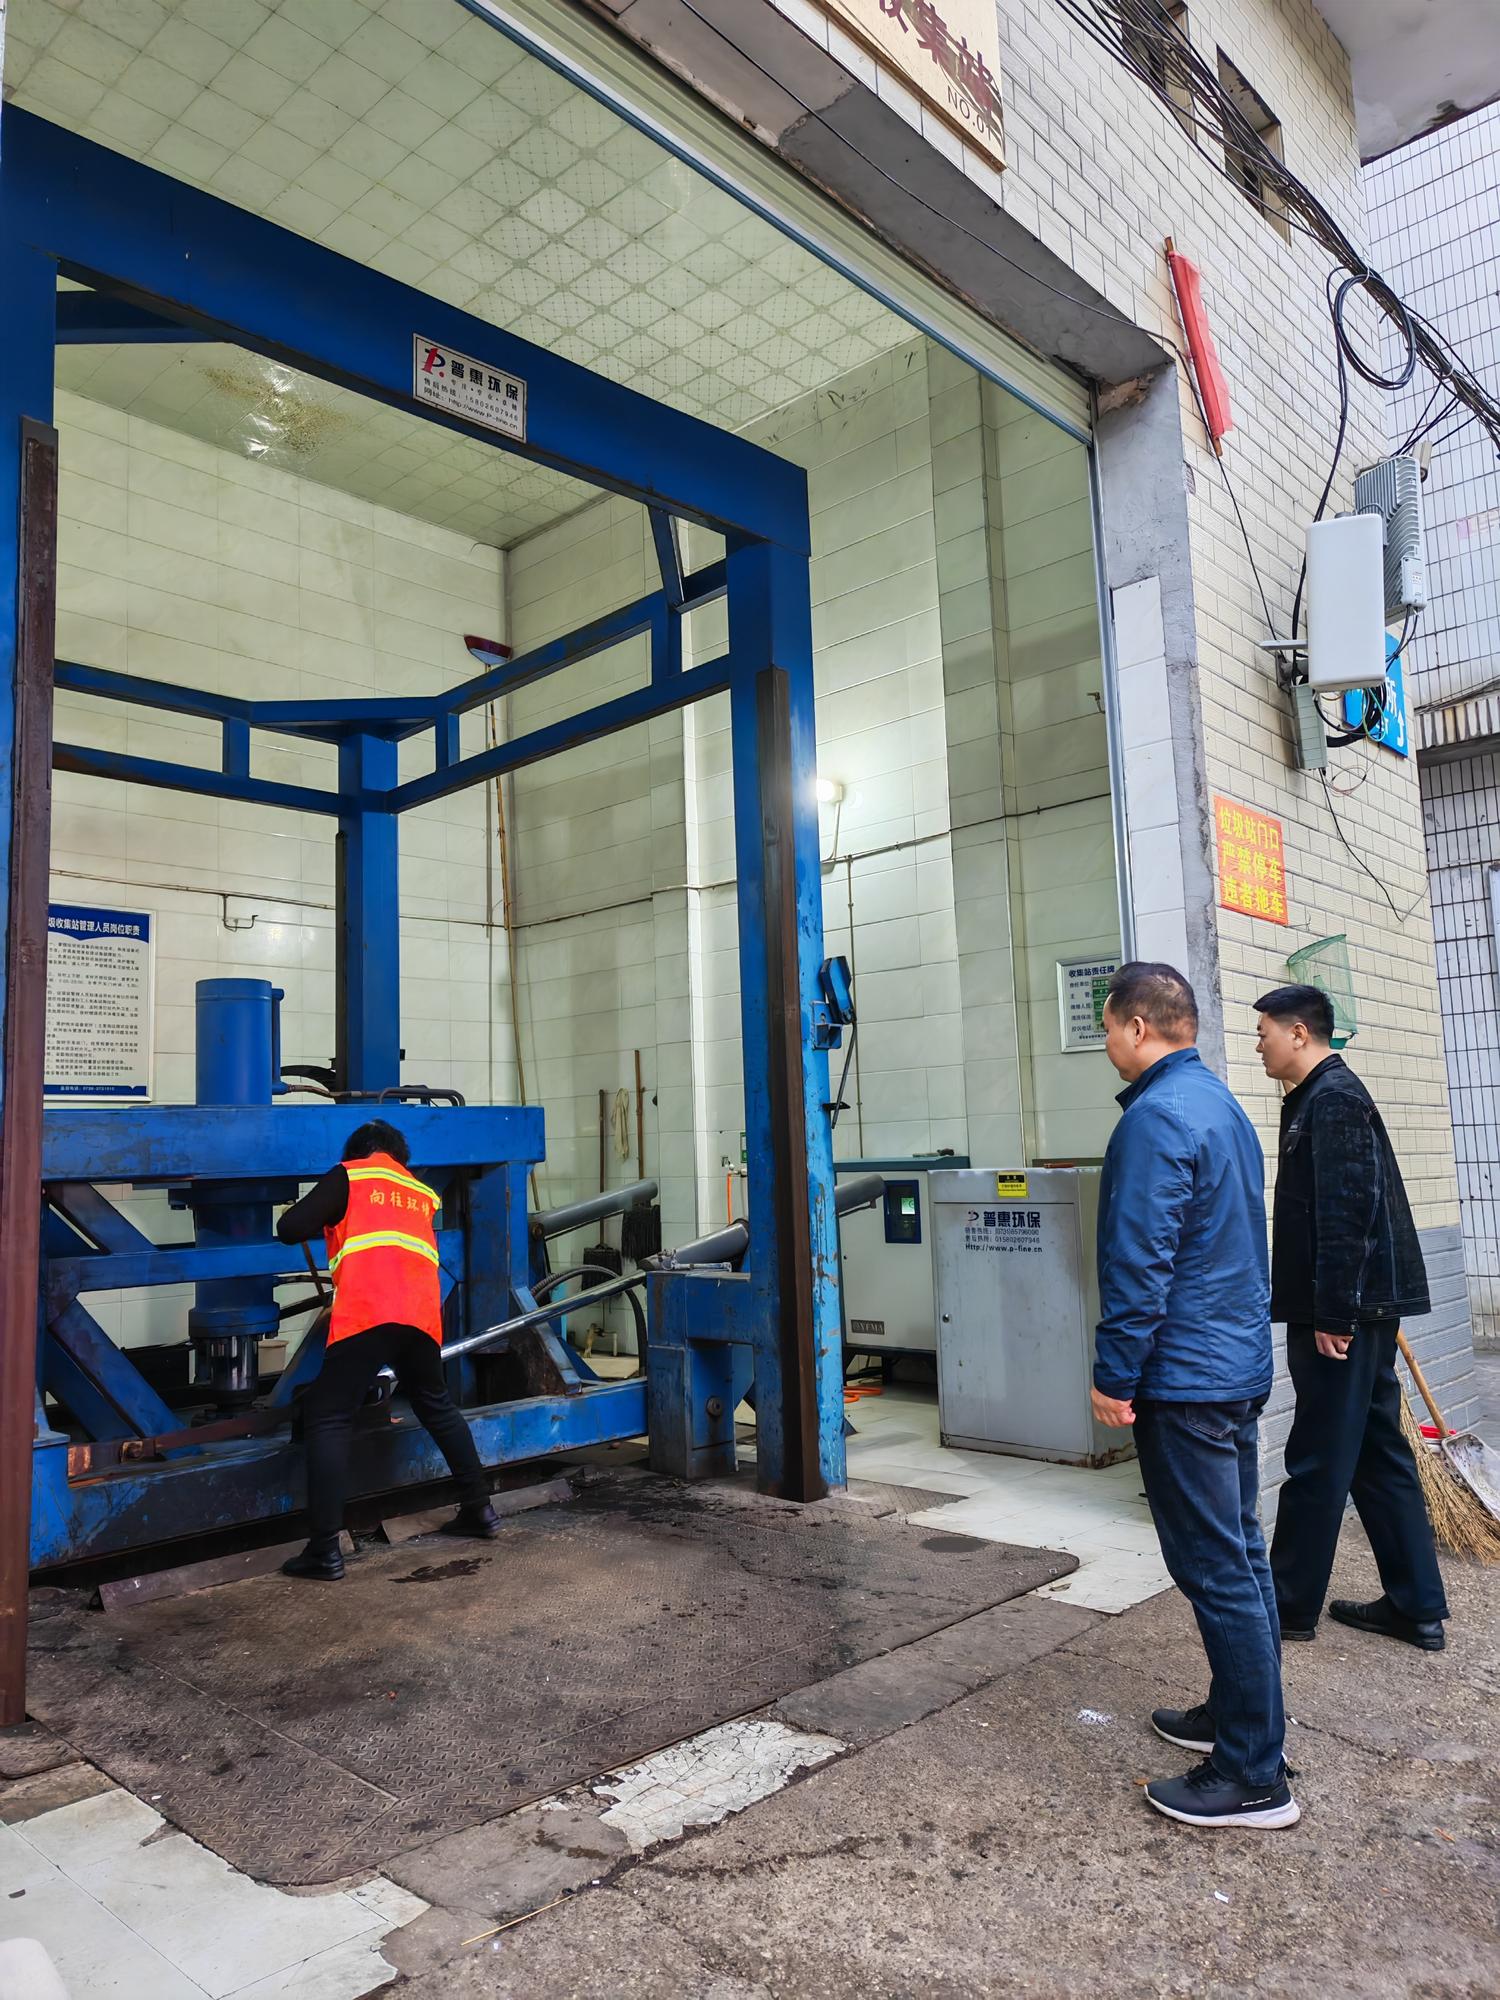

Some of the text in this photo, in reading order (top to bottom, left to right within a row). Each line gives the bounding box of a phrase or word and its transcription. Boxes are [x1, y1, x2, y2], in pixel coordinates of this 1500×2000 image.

[451, 360, 519, 401] 普惠环保
[983, 1211, 1041, 1229] 普惠环保
